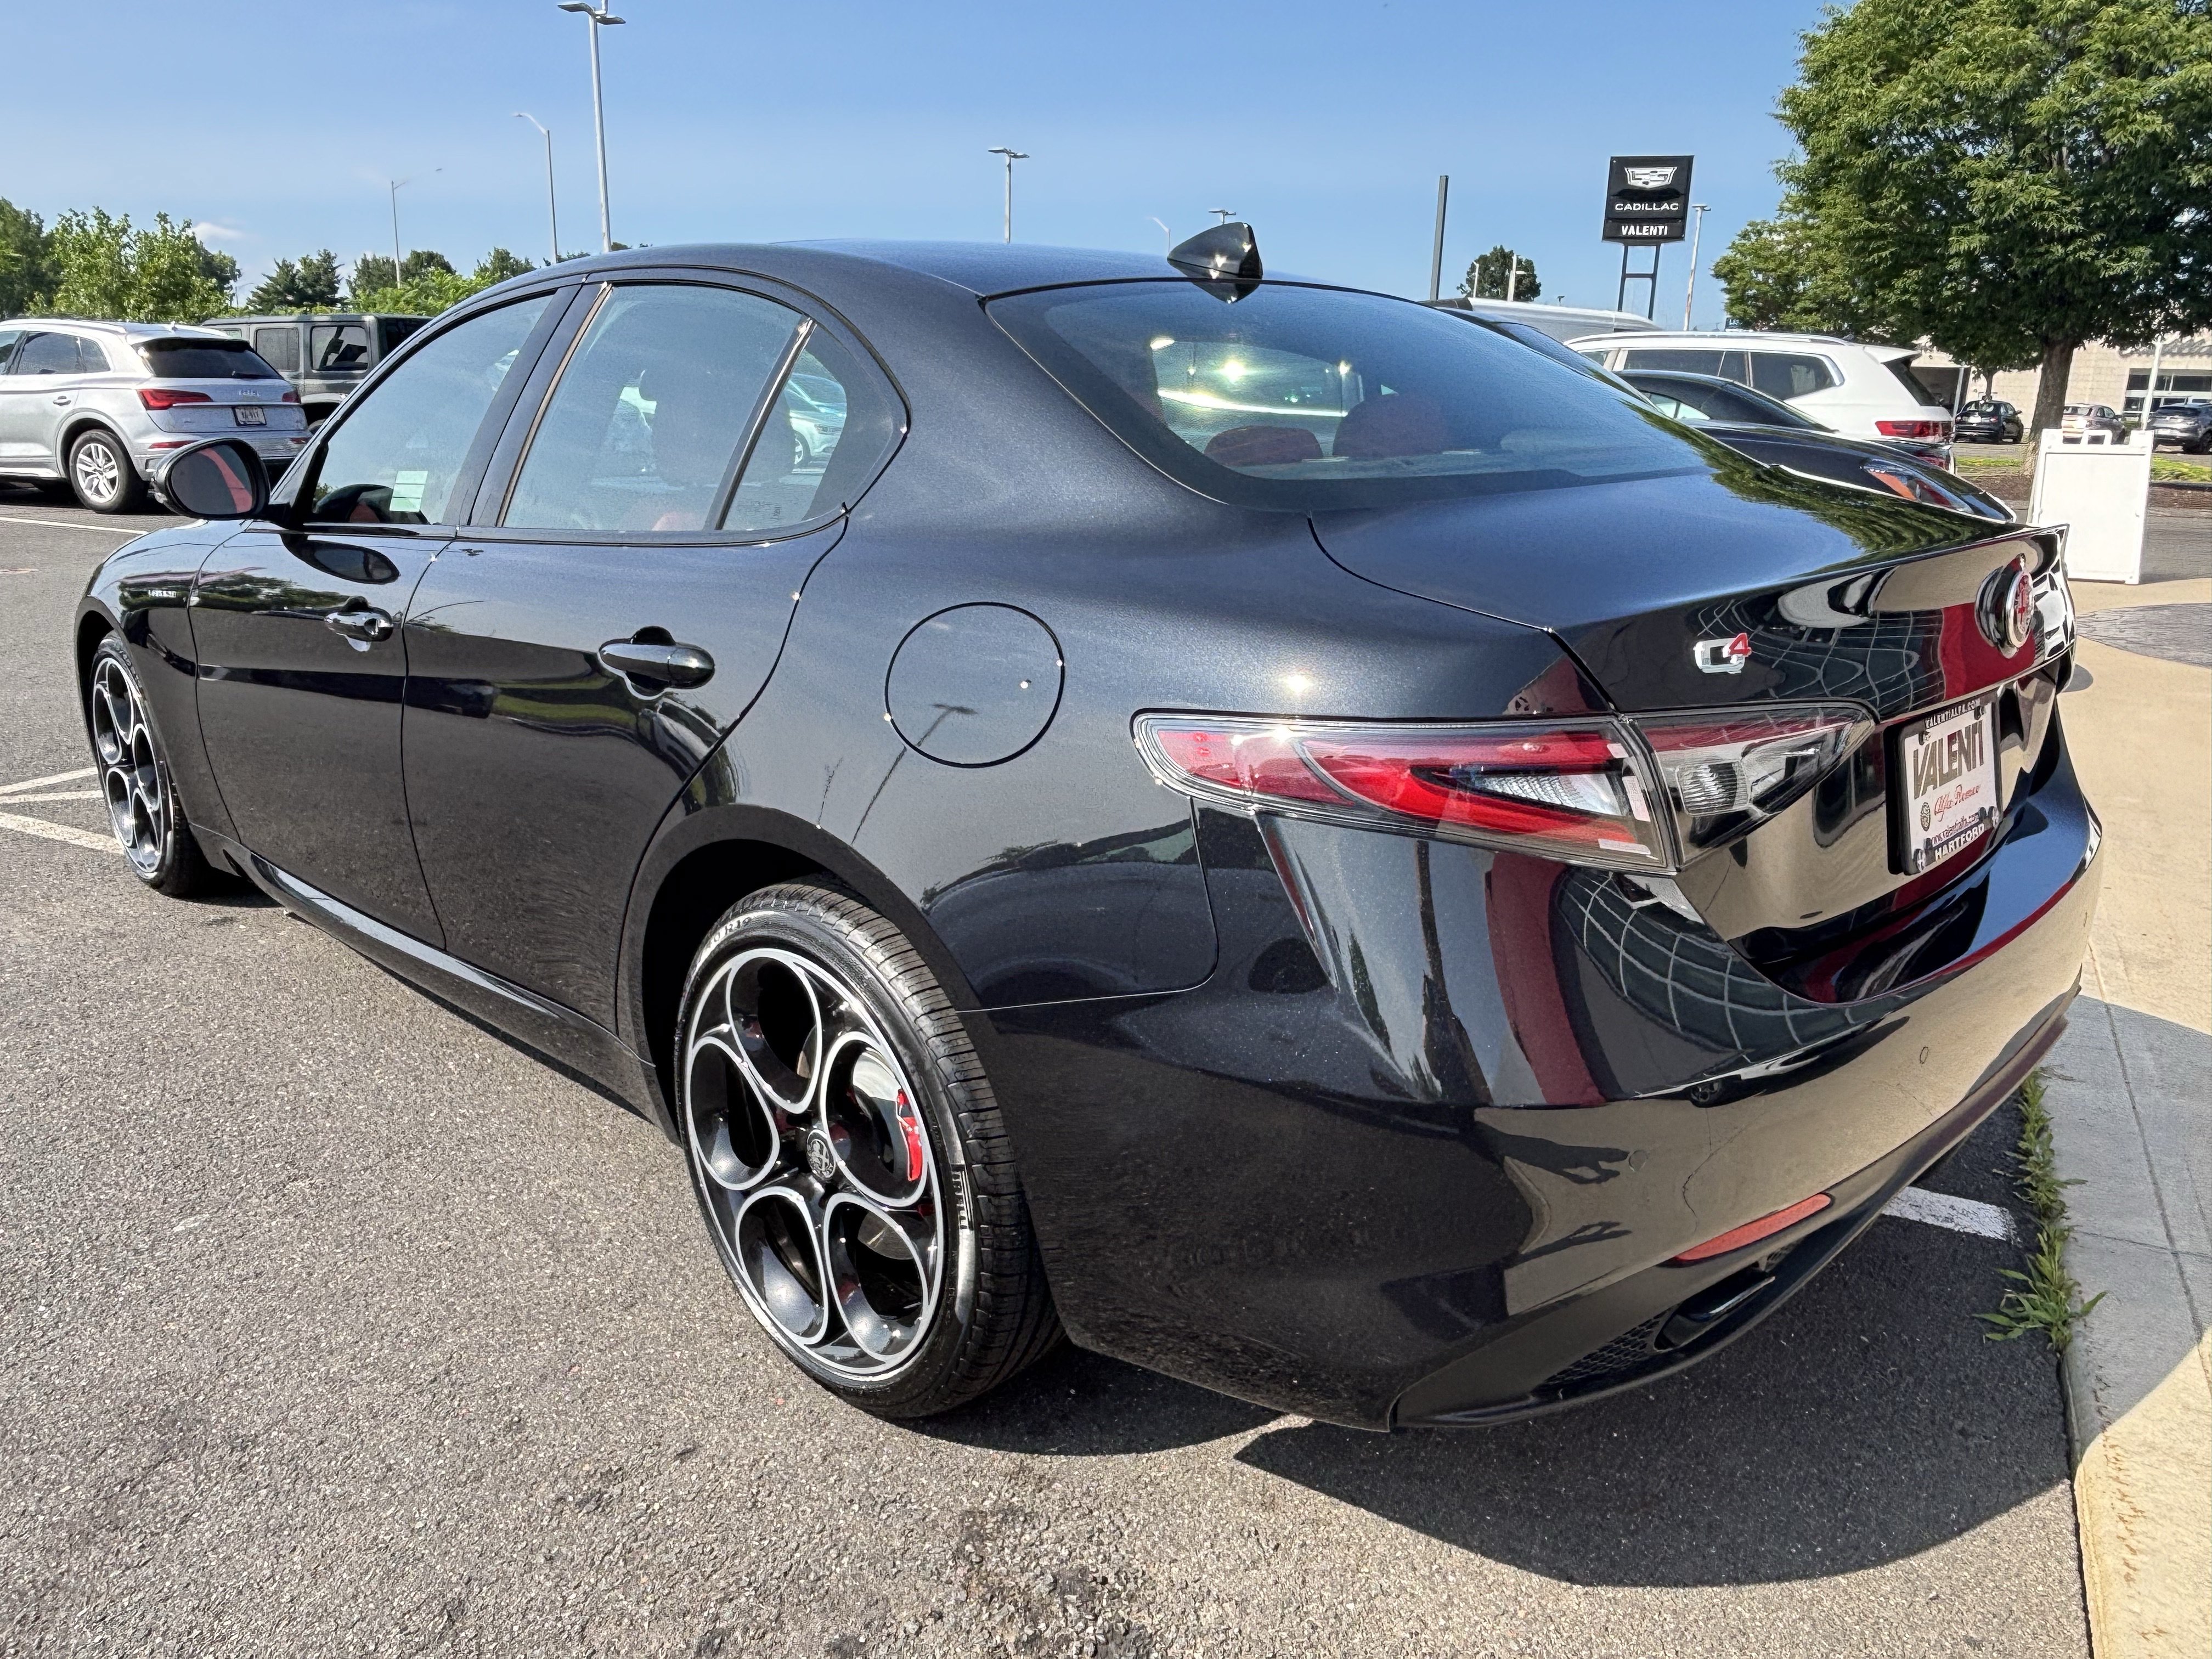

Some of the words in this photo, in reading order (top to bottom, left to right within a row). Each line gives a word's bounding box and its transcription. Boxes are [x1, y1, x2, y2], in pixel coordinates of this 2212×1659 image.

[1615, 202, 1679, 211] CADILLAC
[1621, 225, 1668, 236] VALENTI
[1913, 720, 1984, 800] VALENTI
[1934, 823, 1985, 860] HARTFORD
